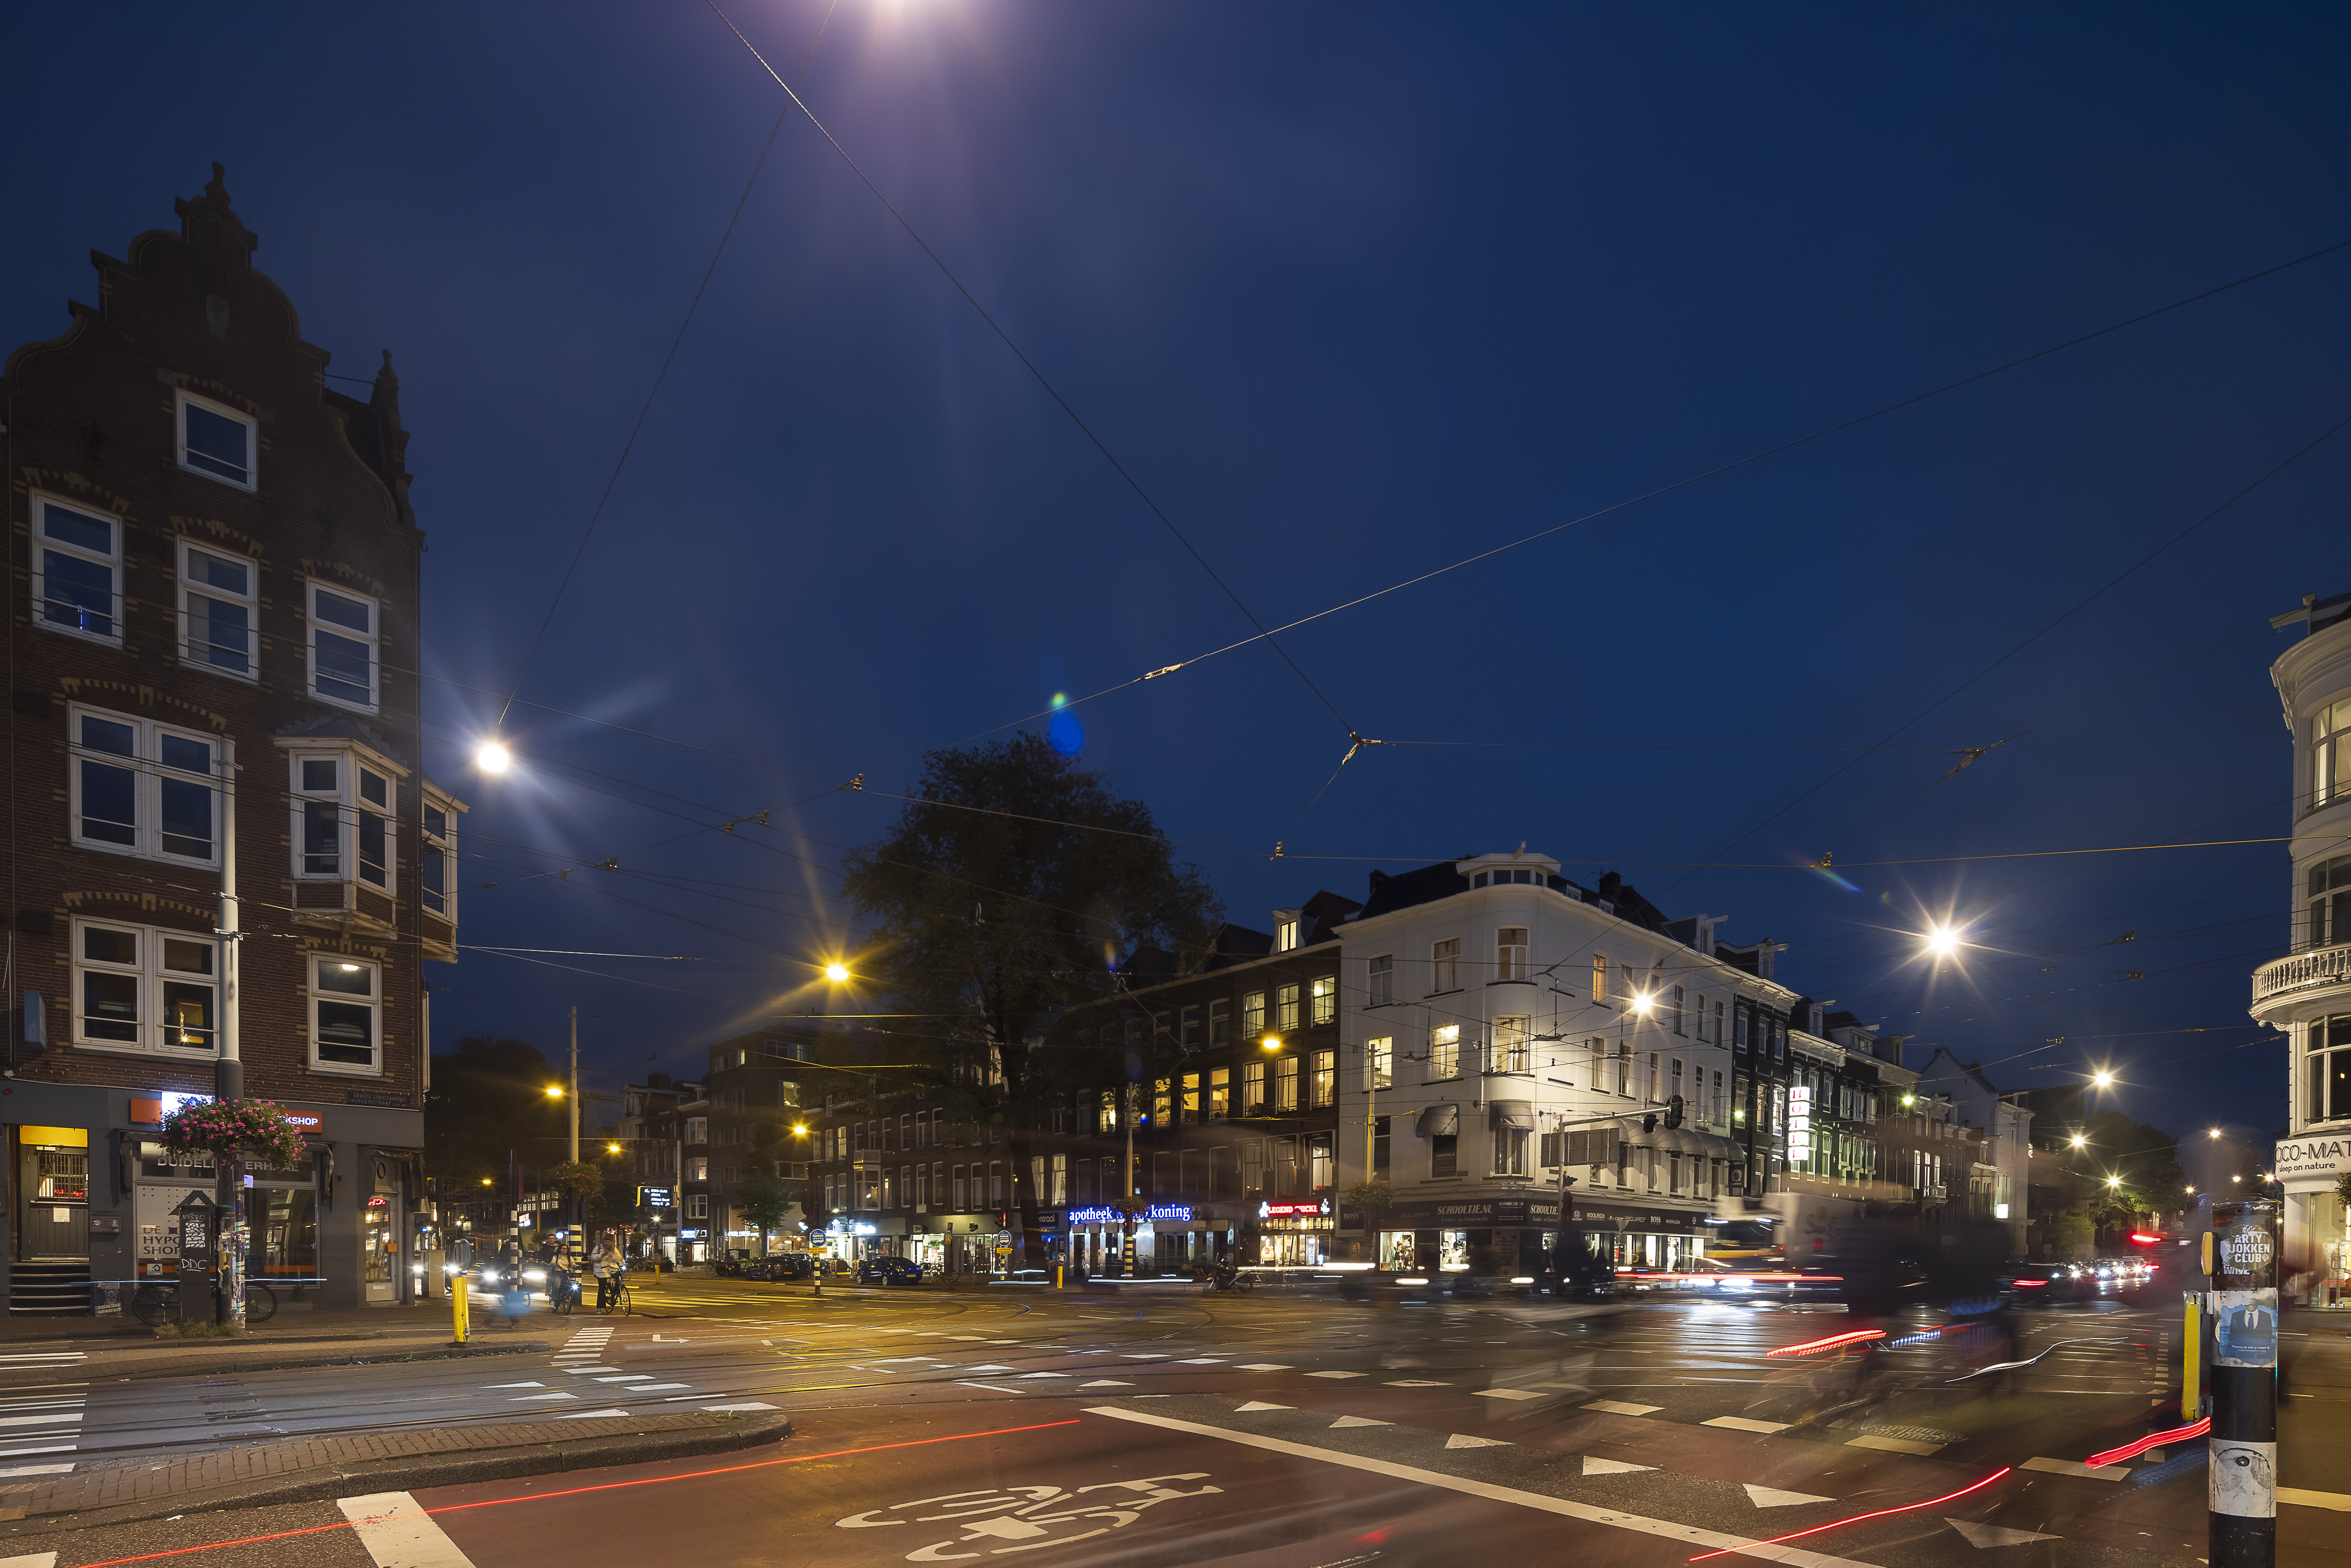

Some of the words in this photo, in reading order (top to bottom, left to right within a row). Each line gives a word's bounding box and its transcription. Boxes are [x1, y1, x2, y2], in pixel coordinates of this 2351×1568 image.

[1791, 1089, 1801, 1158] HOTEL
[2274, 1141, 2351, 1163] OCO-MAT
[2279, 1164, 2292, 1173] sleep
[1069, 1206, 1113, 1225] apotheek
[1150, 1204, 1191, 1222] koning
[1437, 1204, 1493, 1215] SCHOOLTJE.NL
[143, 1226, 161, 1234] DE
[2234, 1234, 2262, 1243] ARTY
[181, 1258, 207, 1269] DDC
[2234, 1253, 2262, 1263] CLUB
